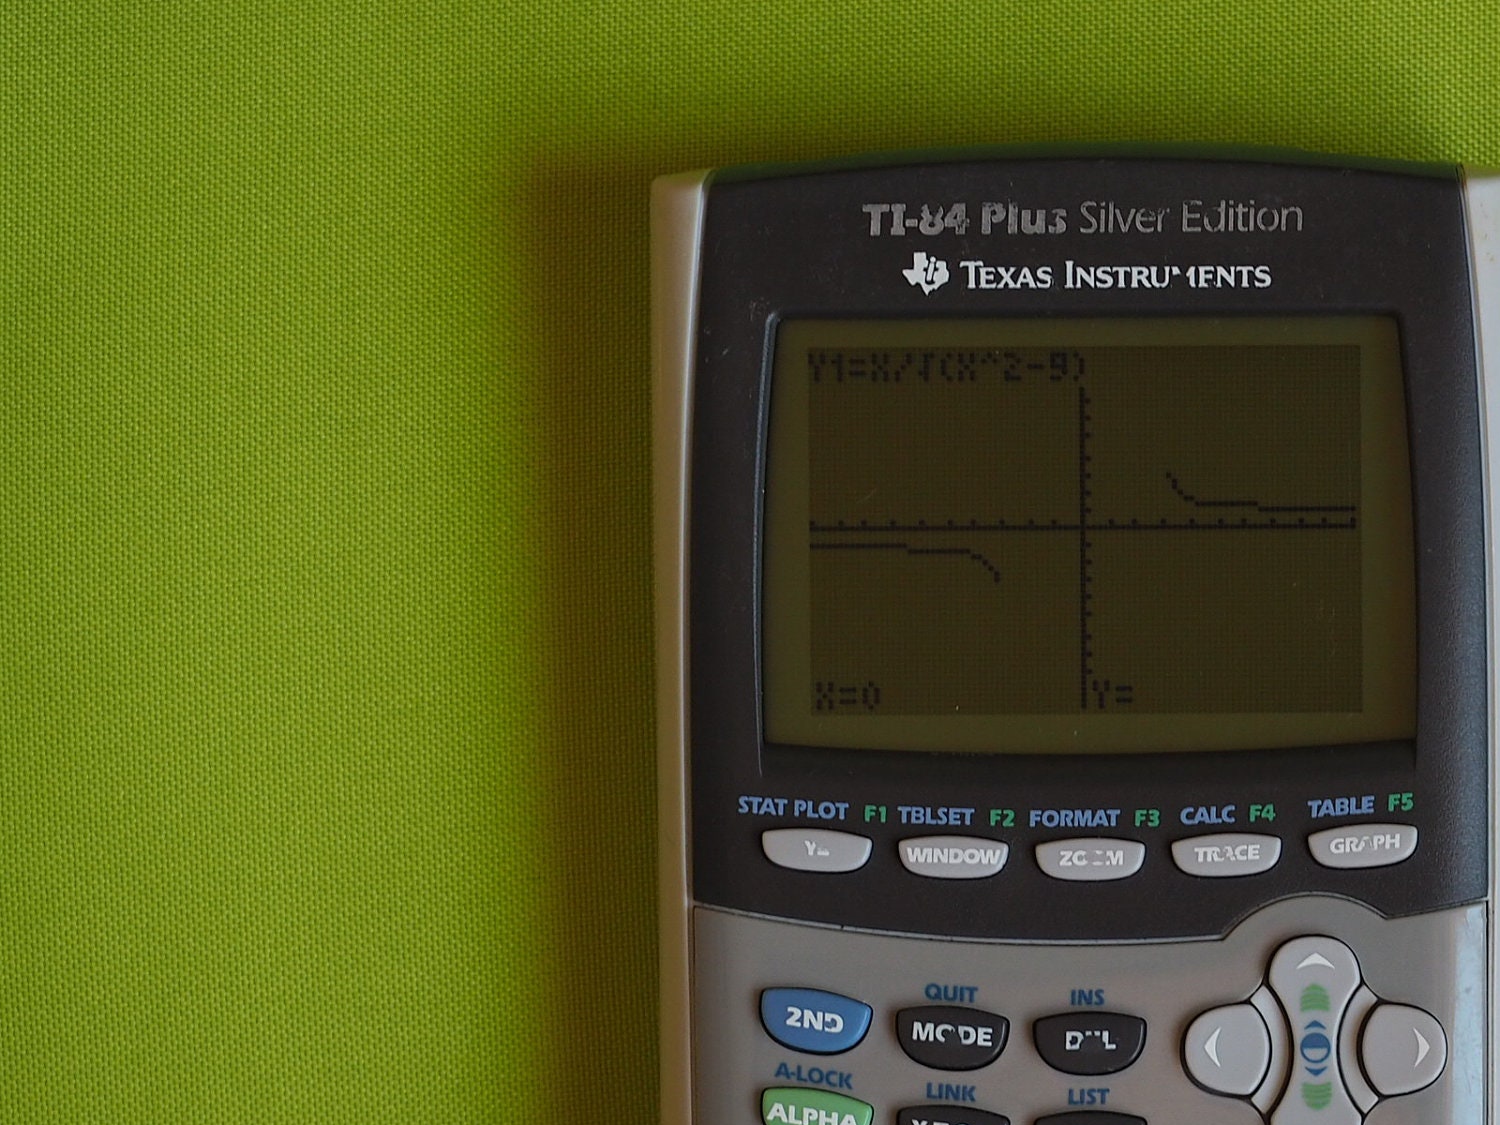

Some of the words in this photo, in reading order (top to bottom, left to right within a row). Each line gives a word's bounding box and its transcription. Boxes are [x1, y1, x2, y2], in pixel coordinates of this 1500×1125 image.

[862, 202, 970, 236] TI-84
[981, 199, 1067, 235] Plus
[1080, 200, 1170, 233] Silver
[1182, 200, 1303, 233] Edition
[960, 261, 1053, 289] TEXAS
[738, 796, 788, 816] STAT
[794, 800, 849, 820] PLOT
[1308, 796, 1375, 818] TABLE
[1387, 793, 1414, 811] F5
[864, 805, 887, 823] F1
[898, 806, 975, 825] TBLSET
[990, 809, 1015, 827] F2
[1029, 809, 1120, 827] FORMAT
[1135, 809, 1161, 827] F3
[1180, 805, 1235, 825] CALC
[1249, 805, 1276, 822] F4
[907, 847, 1001, 865] WINDOW
[924, 983, 978, 1004] QUIT
[1071, 989, 1104, 1006] INS
[785, 1007, 843, 1033] 2ND
[774, 1062, 853, 1089] A-LOCK
[926, 1082, 976, 1101] LINK
[1068, 1088, 1110, 1105] LIST
